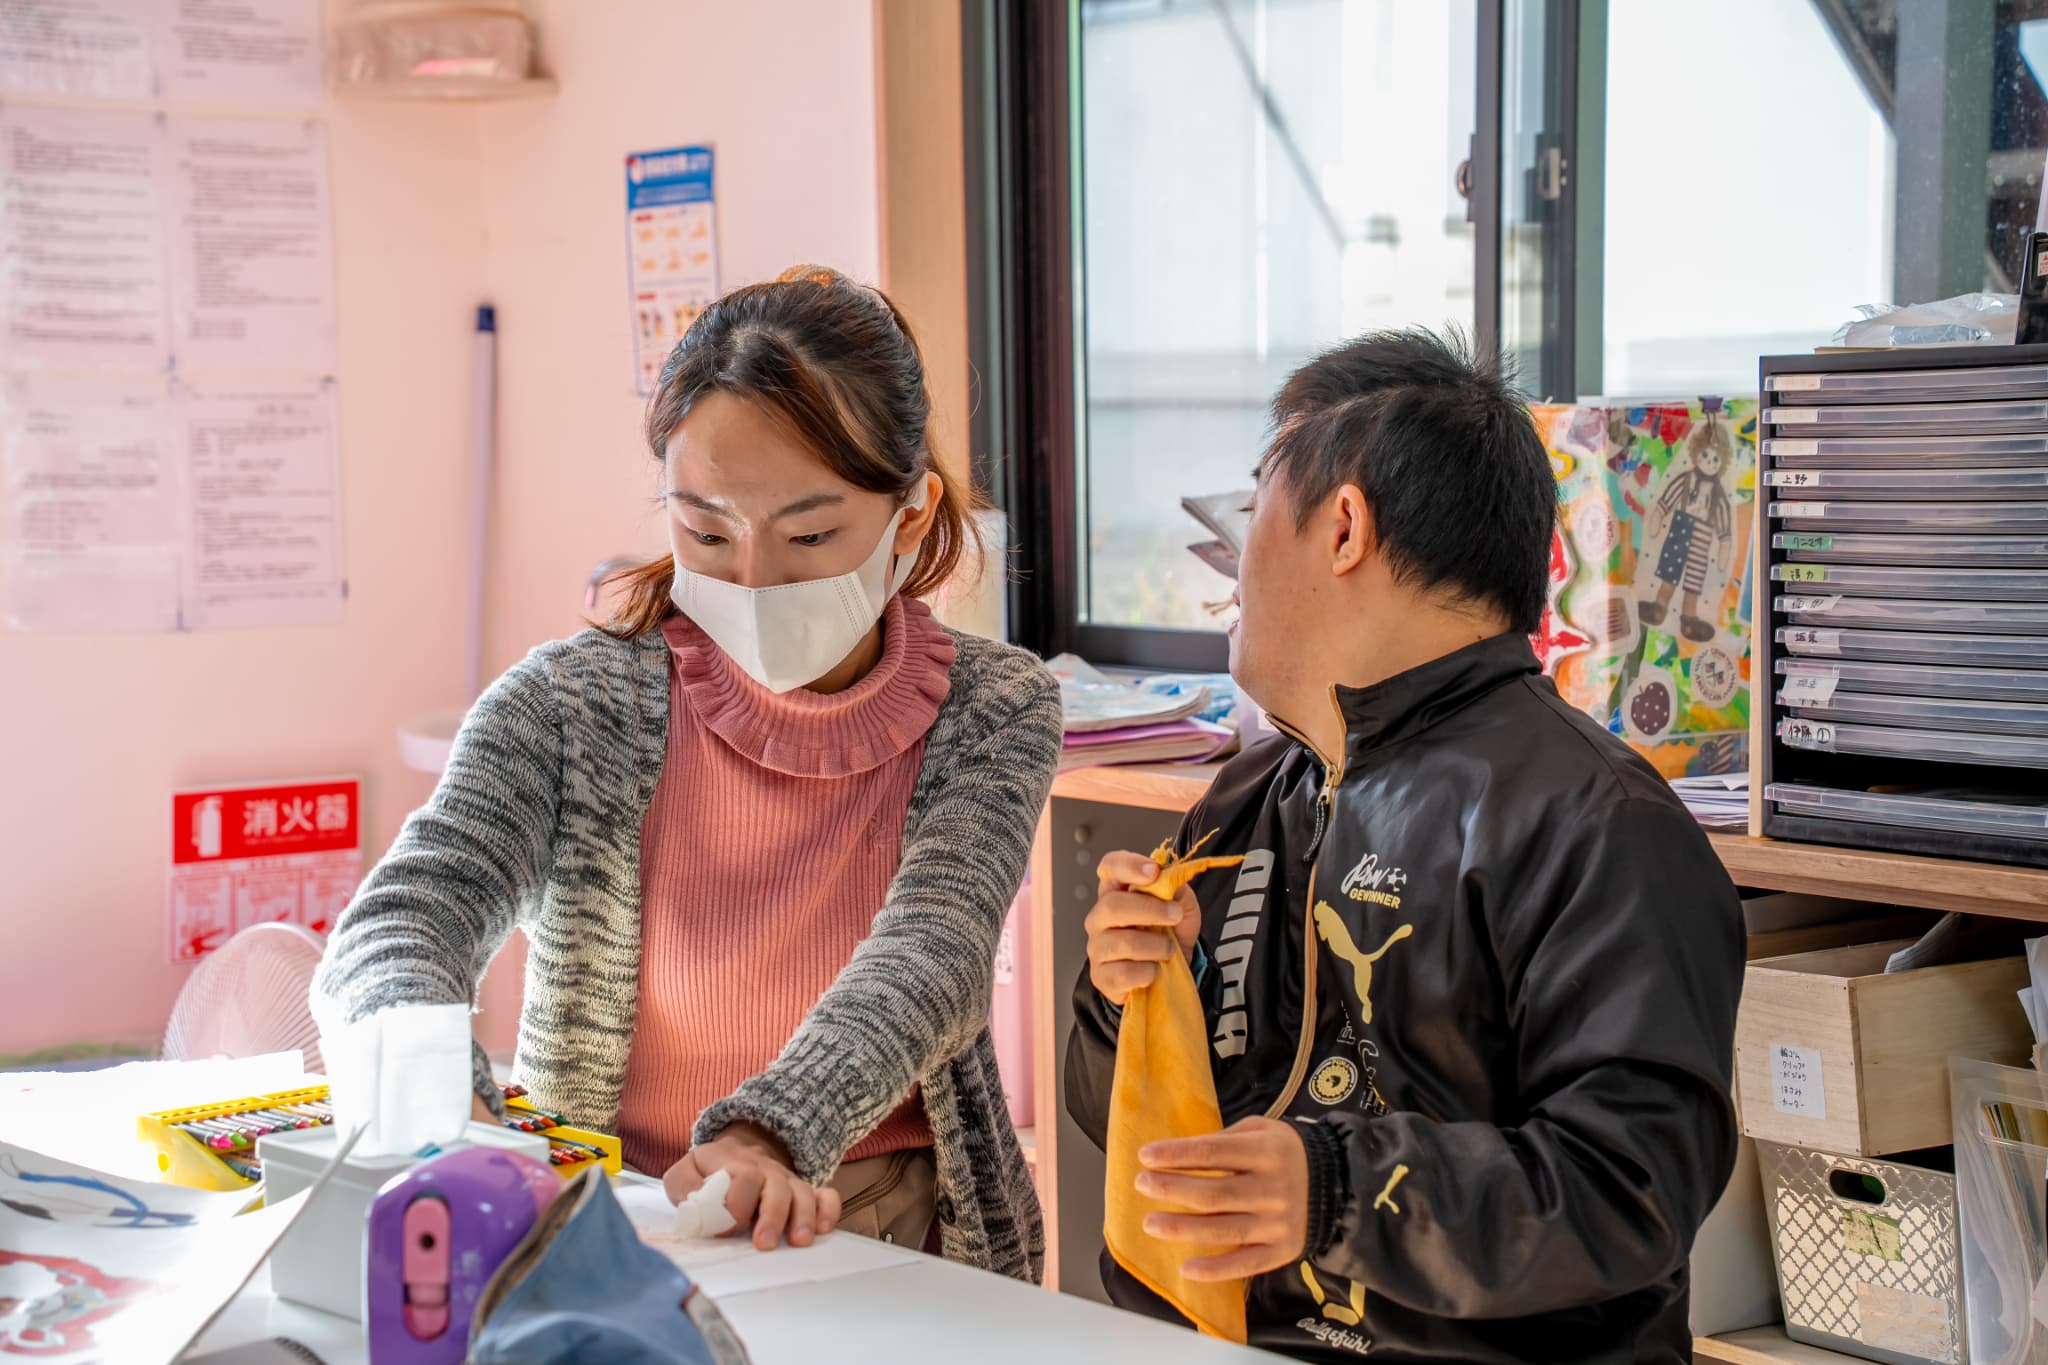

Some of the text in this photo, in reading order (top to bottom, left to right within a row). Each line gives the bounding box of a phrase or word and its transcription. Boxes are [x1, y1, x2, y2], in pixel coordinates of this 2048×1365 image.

[1782, 473, 1808, 485] 上野
[243, 793, 349, 837] 消火器
[1349, 887, 1401, 910] GEWINNER
